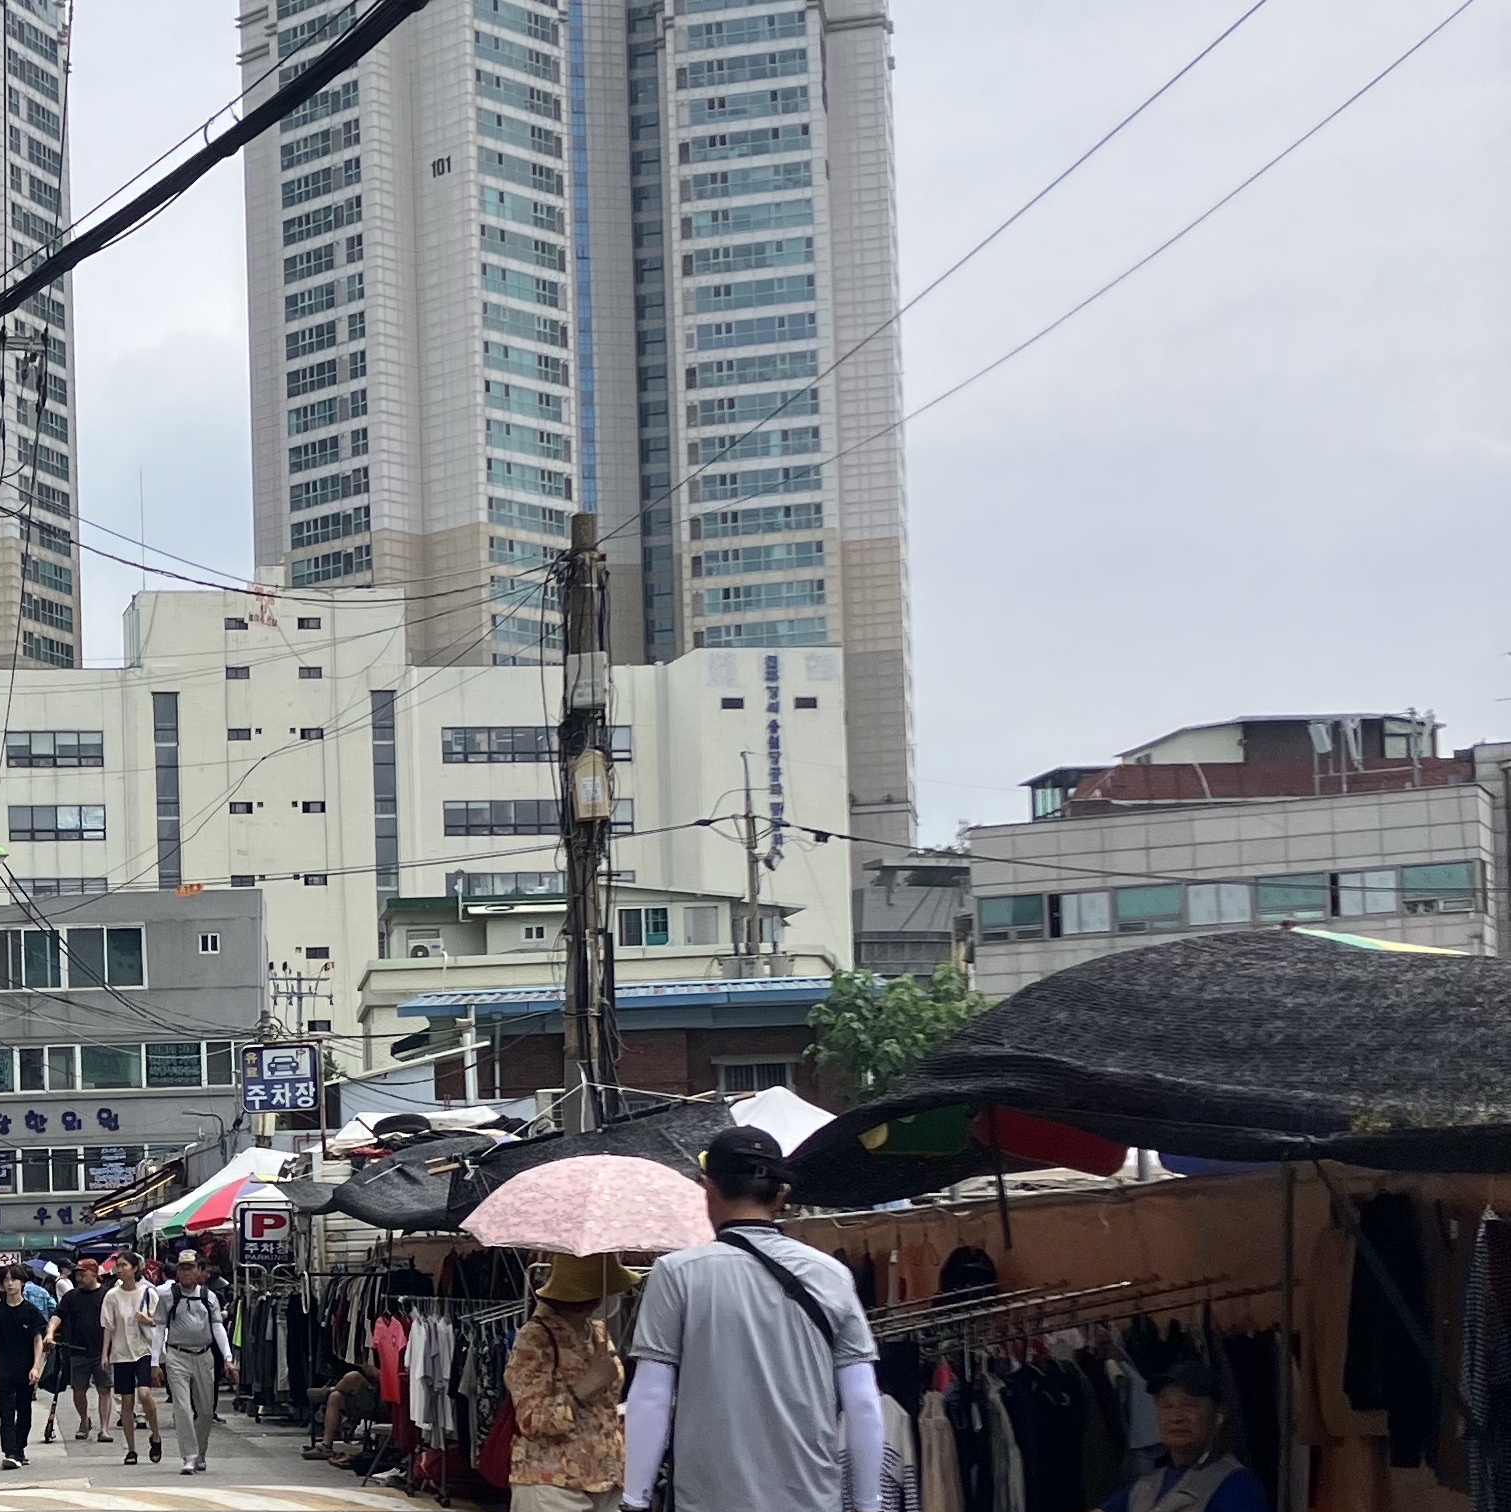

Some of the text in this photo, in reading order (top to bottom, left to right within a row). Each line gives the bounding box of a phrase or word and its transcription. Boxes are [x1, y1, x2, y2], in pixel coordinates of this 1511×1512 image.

[430, 155, 451, 178] 101
[246, 1081, 315, 1110] 주차장
[252, 1214, 287, 1238] P
